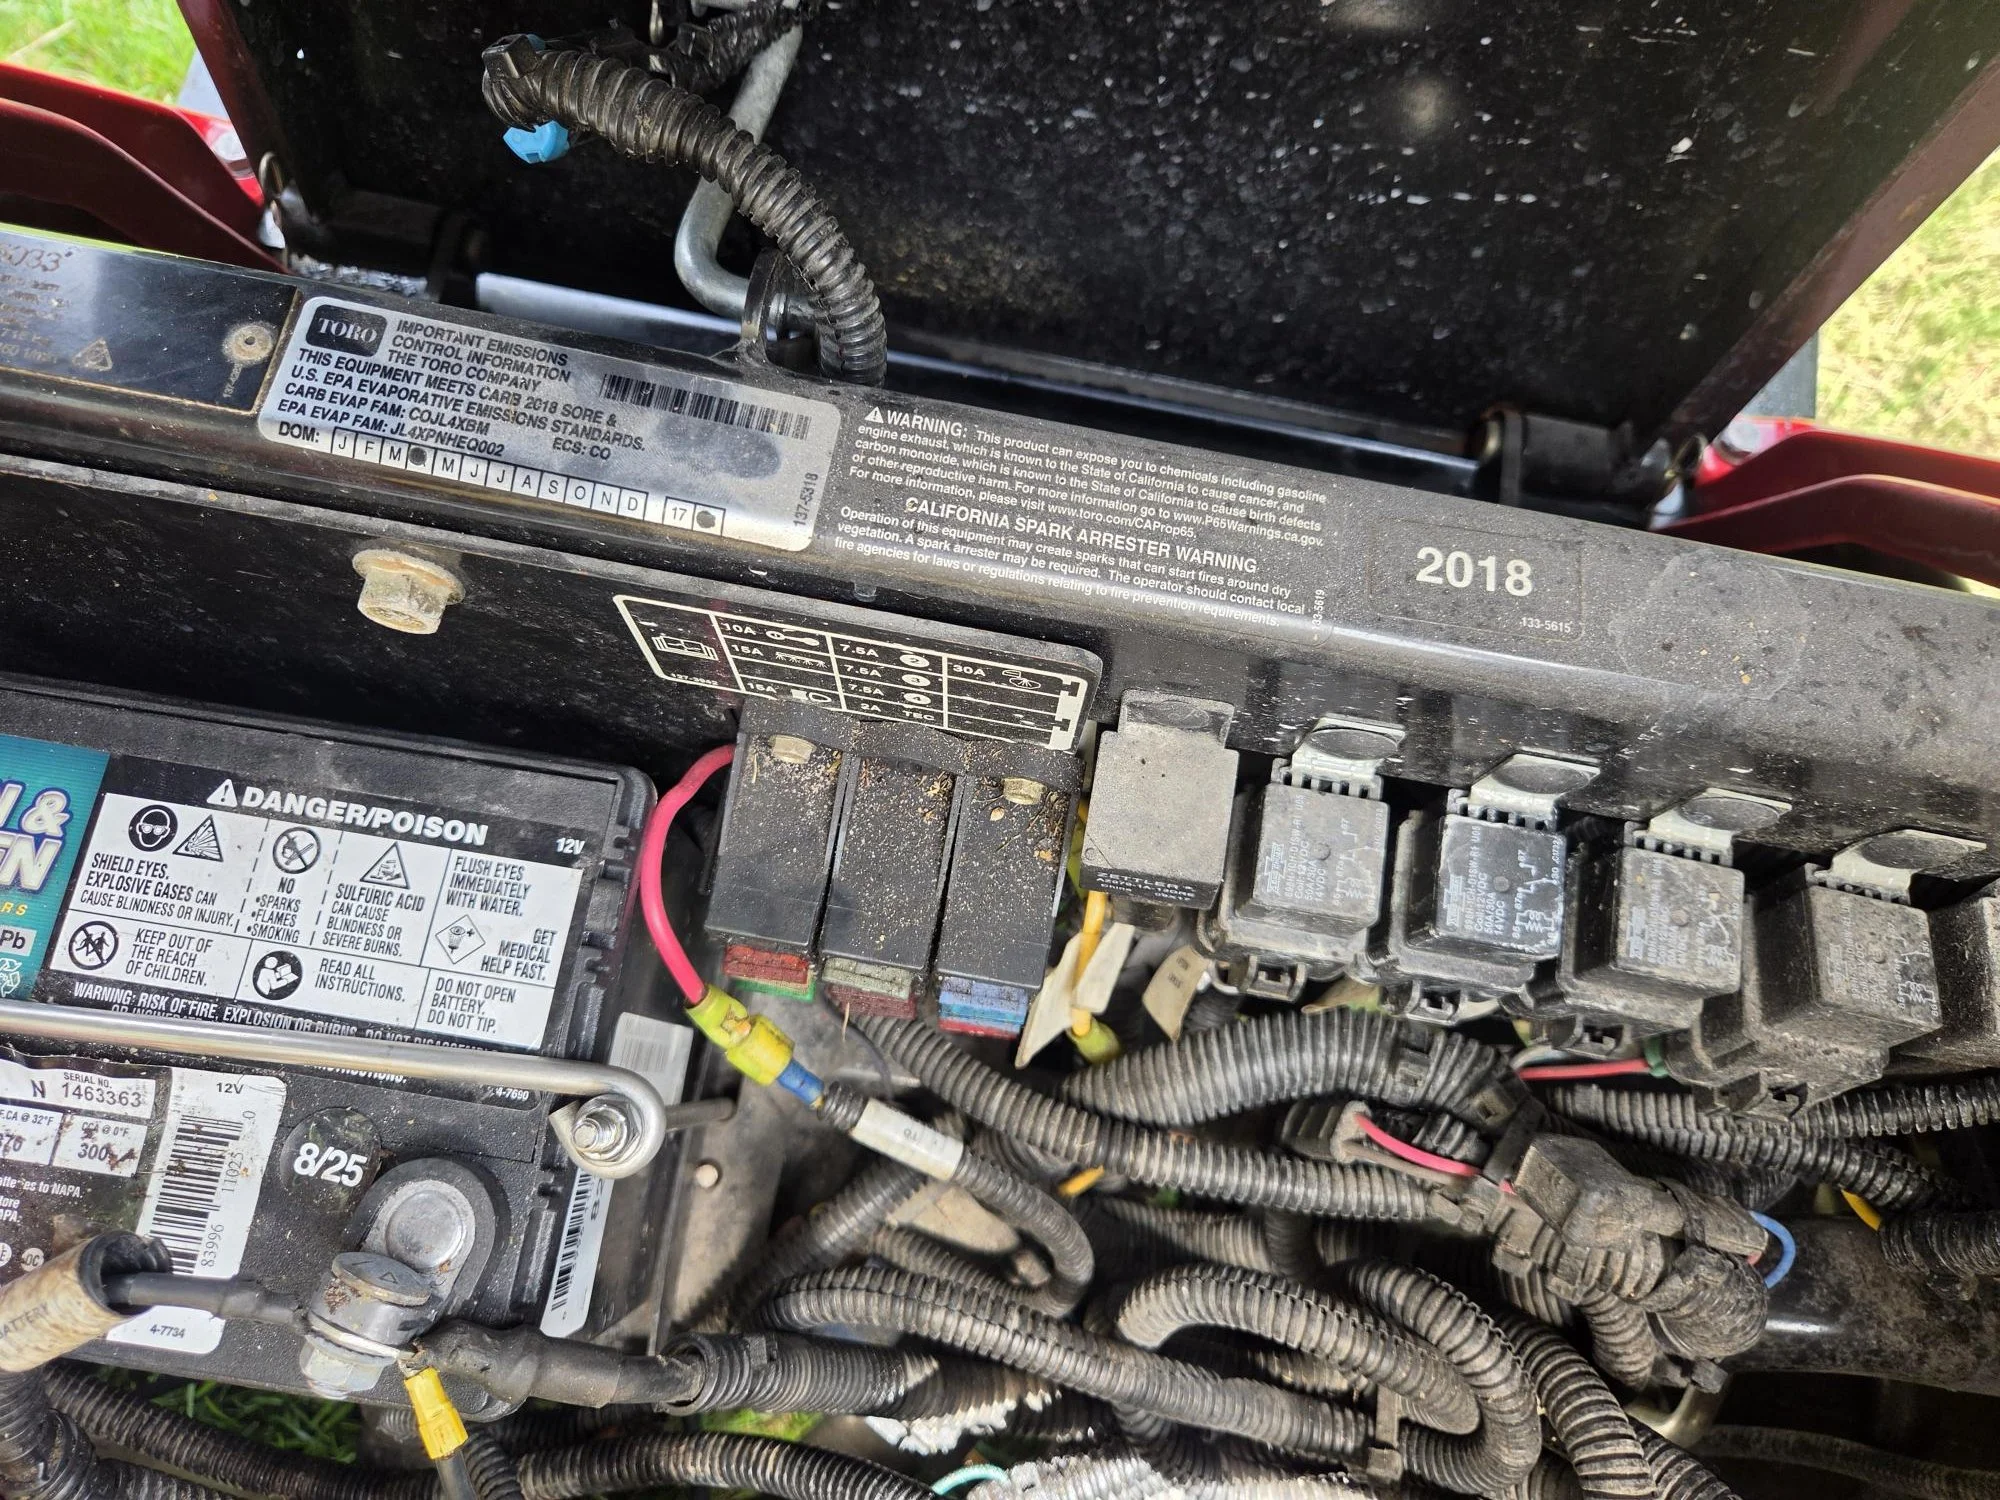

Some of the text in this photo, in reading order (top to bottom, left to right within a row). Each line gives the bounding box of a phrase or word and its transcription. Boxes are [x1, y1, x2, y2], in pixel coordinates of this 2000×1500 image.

[320, 319, 376, 343] TORO
[396, 320, 570, 366] IMPORTANT EMISSIONS
[388, 349, 540, 391] THE TORO COMPANY
[392, 334, 571, 382] CONTROL INFORMATION
[299, 347, 616, 427] THIS EQUIPMENT MEETS CARB 2018 SORE &
[285, 382, 326, 401] CARB
[328, 390, 368, 409] EVAP
[370, 399, 405, 418] FAM:
[291, 364, 644, 450] U.S. EPA EVAPORATIVE EMISSIONS STANDARDS.
[277, 398, 306, 415] EPA
[310, 405, 350, 423] EVAP
[351, 414, 387, 432] FAM:
[278, 421, 319, 442] DOM:
[552, 436, 610, 460] ECS: CO
[887, 410, 1326, 504] WARNING: This product can expose you to chemicals including gasoline
[793, 472, 818, 525] 137-5318
[848, 465, 1195, 540] For more information, please visit www.toro.com/CAProp65.
[671, 506, 687, 521] 17
[905, 497, 1256, 572] CALIFORNIA SPARK ARRESTER WARNING
[840, 505, 1291, 599] Operation of this equipment may create sparks that can start fires around dry
[1416, 546, 1534, 597] 2018
[721, 622, 756, 636] 10A
[1521, 617, 1572, 633] 133-5615
[732, 644, 764, 656] 15A
[840, 644, 879, 657] 7.5A
[844, 665, 882, 677] 7.5A
[953, 665, 985, 676] 30A
[747, 682, 777, 693] 15A
[848, 684, 884, 696] 7.5A
[860, 703, 881, 712] 2A
[903, 711, 935, 721] TEC
[246, 787, 585, 854] DANGER/POISON 12V
[91, 852, 168, 879] SHIELD EYES.
[454, 855, 523, 881] FLUSH EYES
[85, 870, 217, 905] EXPLOSIVE GASES CAN
[277, 876, 295, 894] NO
[335, 883, 424, 911] SULFURIC ACID
[449, 873, 530, 898] IMMEDIATELY
[80, 889, 233, 926] CAUSE BLINDNESS OR INJURY.
[259, 893, 300, 912] SPARKS
[331, 900, 389, 922] CAN CAUSE
[445, 889, 521, 916] WITH WATER.
[255, 908, 296, 927] FLAMES
[326, 915, 402, 940] BLINDNESS OR
[1, 929, 26, 949] Pb
[134, 927, 213, 953] KEEP OUT OF
[251, 922, 299, 943] SMOKING
[322, 931, 401, 956] SEVERE BURNS.
[532, 928, 555, 945] GET
[131, 943, 197, 967] THE REACH
[498, 940, 549, 963] MEDICAL
[125, 959, 206, 985] OF CHILDREN.
[319, 957, 374, 980] READ ALL
[480, 954, 545, 980] HELP FAST.
[315, 974, 404, 1001] INSTRUCTIONS.
[435, 976, 516, 1003] DO NOT OPEN
[74, 981, 135, 1004] WARNING:
[137, 991, 168, 1010] RISK
[169, 997, 188, 1013] OF
[188, 1000, 218, 1020] FIRE,
[223, 1004, 291, 1031] EXPLOSION
[294, 1016, 312, 1031] OR
[431, 992, 484, 1014] BATTERY.
[426, 1008, 495, 1033] DO NOT TIP.
[31, 1079, 46, 1098] N
[63, 1072, 112, 1089] SERIAL NO.
[216, 1082, 244, 1095] 12V
[62, 1082, 143, 1108] 1463363
[77, 1142, 109, 1161] 300
[293, 1142, 368, 1187] 8/25
[51, 1183, 83, 1198] NAPA.
[200, 1223, 225, 1267] 83996
[150, 1325, 186, 1338] 4-7734
